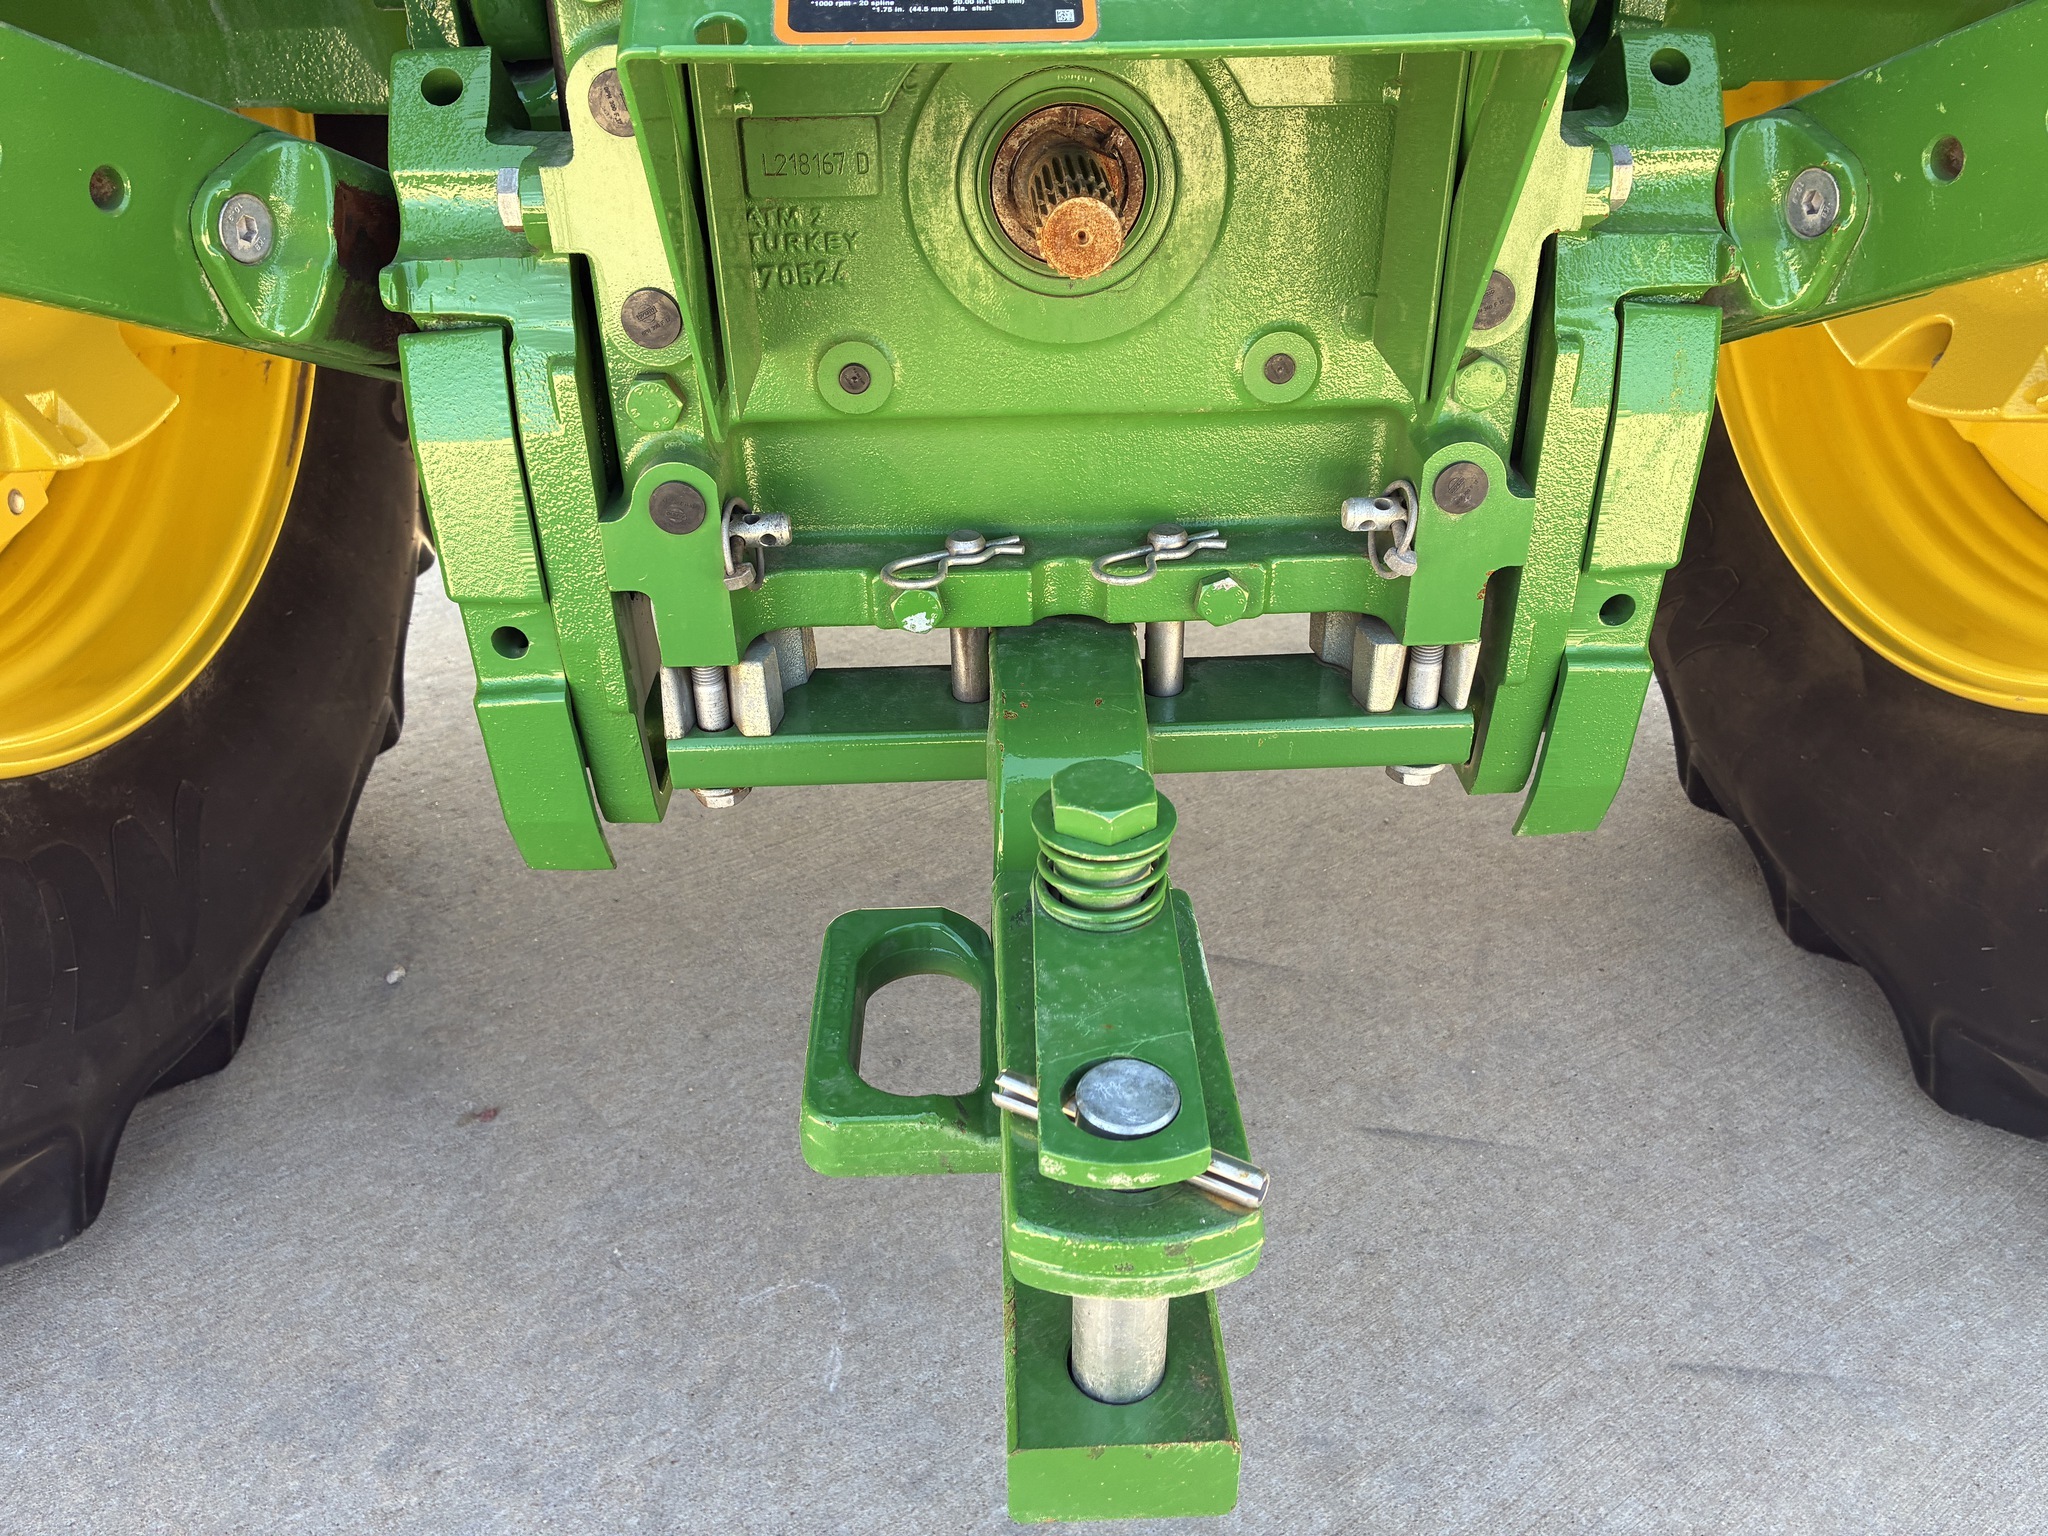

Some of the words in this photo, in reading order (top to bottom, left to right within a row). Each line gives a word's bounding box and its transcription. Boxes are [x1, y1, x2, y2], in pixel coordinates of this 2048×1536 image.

[762, 152, 845, 178] L218167
[856, 152, 870, 175] D
[749, 230, 862, 254] TURKEY
